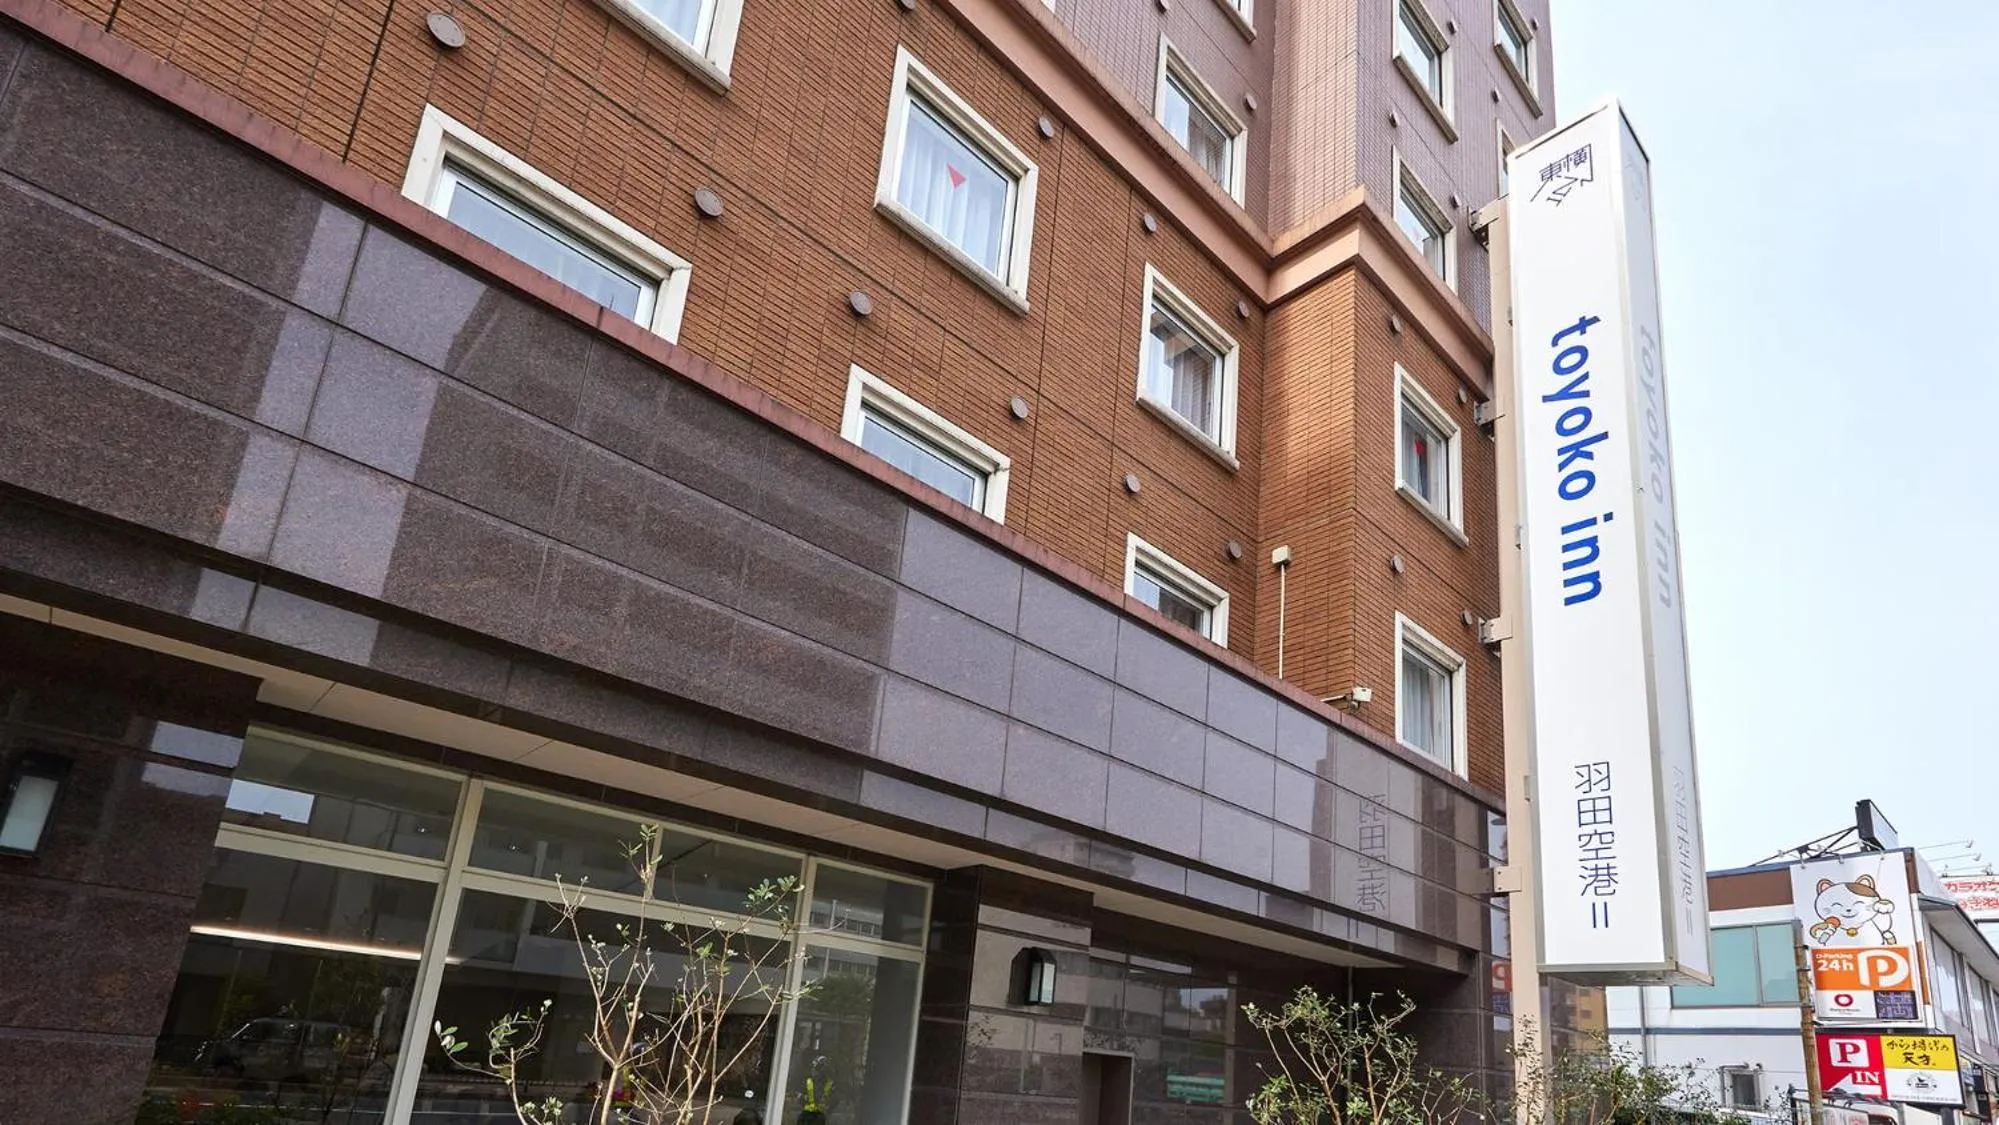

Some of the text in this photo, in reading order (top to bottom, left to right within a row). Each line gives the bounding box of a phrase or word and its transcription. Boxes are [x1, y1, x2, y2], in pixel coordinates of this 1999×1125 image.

[1541, 315, 1614, 606] toyoko inn
[1817, 959, 1854, 972] 24h
[1857, 948, 1910, 988] P
[1836, 1041, 1862, 1063] P
[1855, 1071, 1880, 1084] IN
